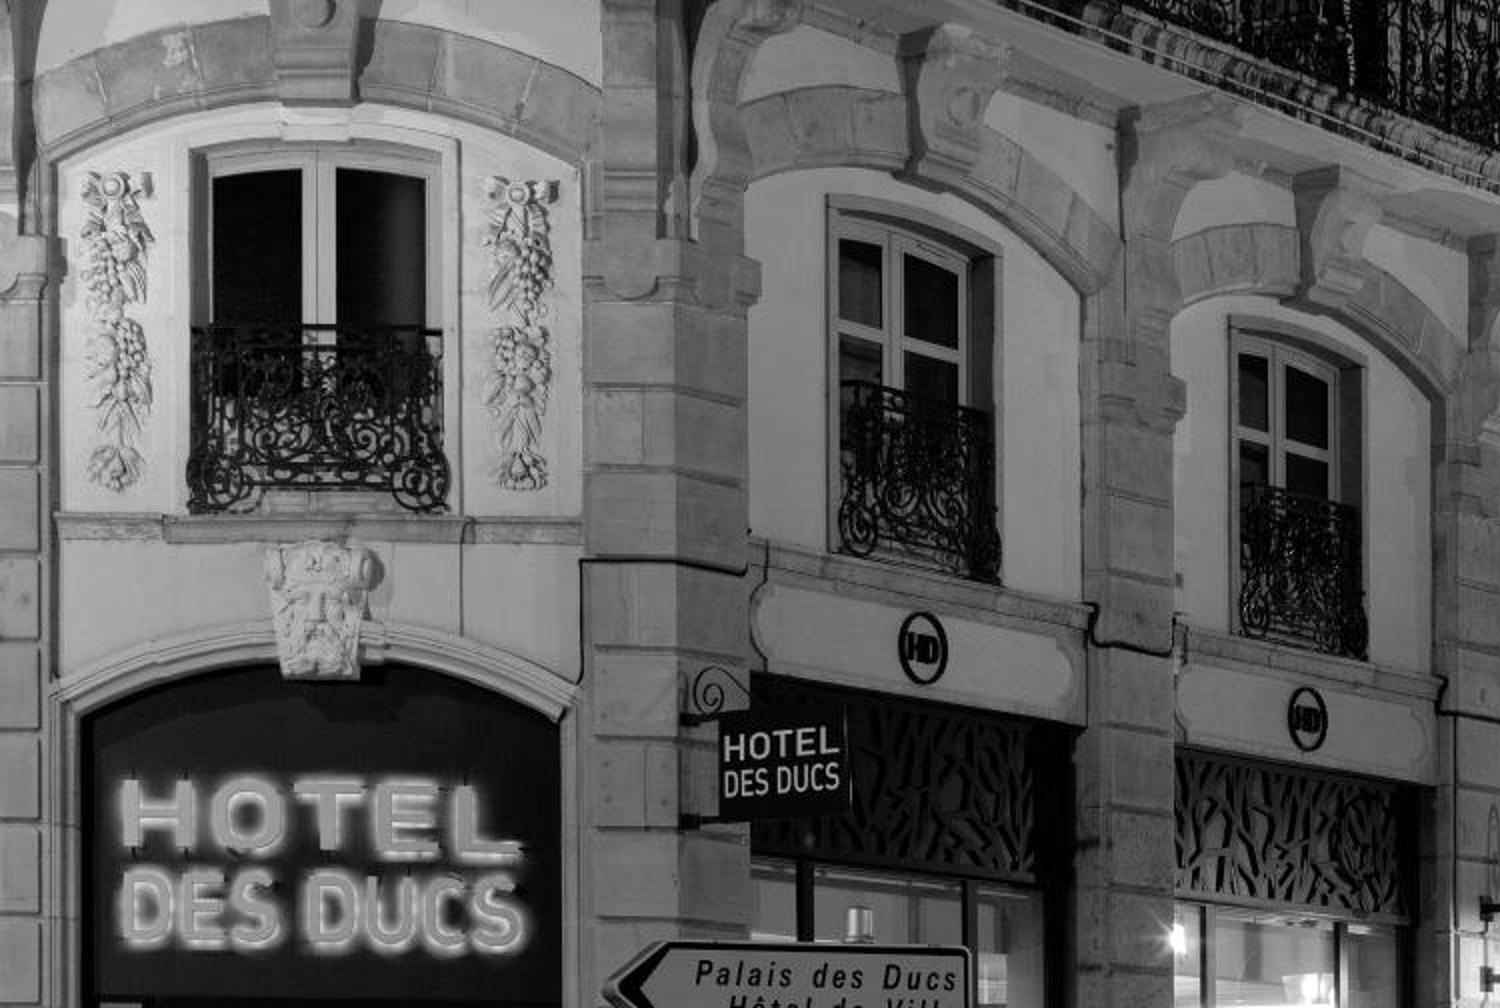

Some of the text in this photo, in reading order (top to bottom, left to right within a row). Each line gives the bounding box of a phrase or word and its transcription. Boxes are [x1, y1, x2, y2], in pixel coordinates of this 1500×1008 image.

[723, 725, 841, 763] HOTEL
[724, 761, 841, 799] DES DUCS
[119, 776, 524, 862] HOTEL
[121, 867, 526, 952] DES DUCS
[695, 959, 957, 991] Palais des Ducs
